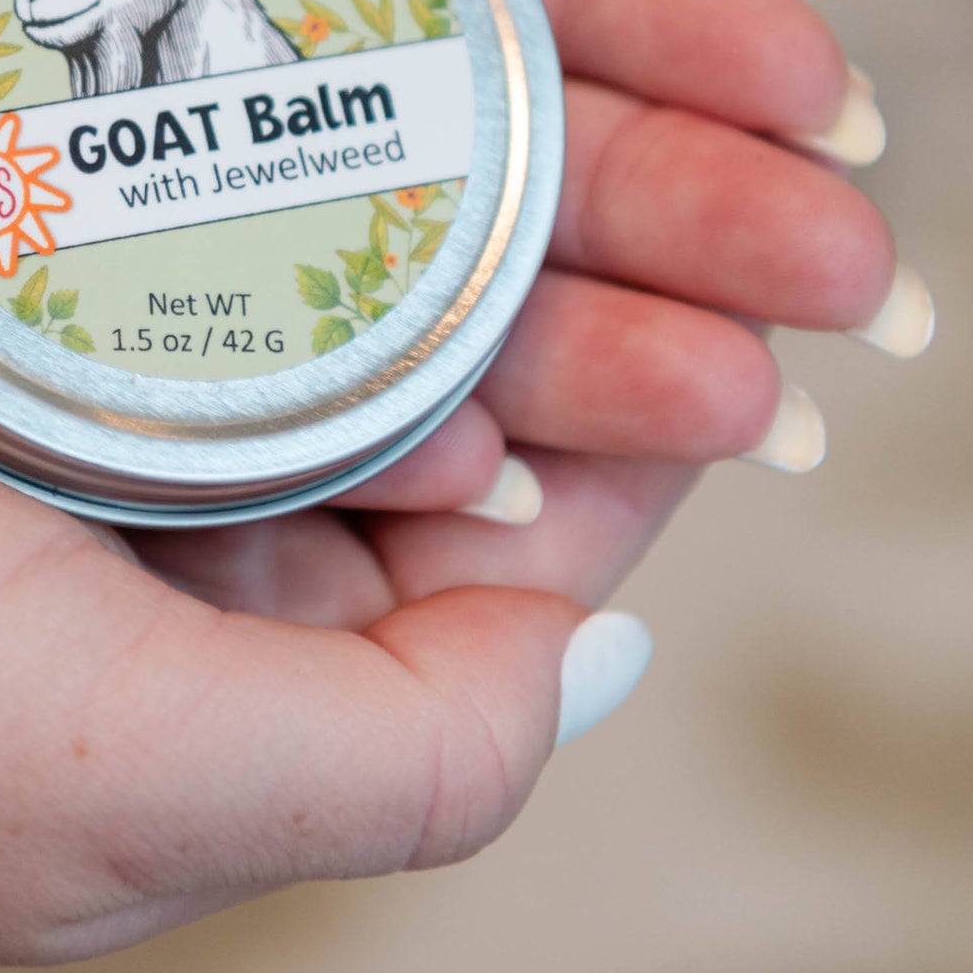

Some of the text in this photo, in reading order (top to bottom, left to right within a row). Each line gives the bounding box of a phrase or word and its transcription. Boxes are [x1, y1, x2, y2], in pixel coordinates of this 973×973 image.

[69, 82, 396, 173] GOAT Balm
[119, 130, 407, 209] with Jewelweed
[148, 292, 252, 317] Net WT
[112, 326, 285, 357] 1.5 oz / 42 G
